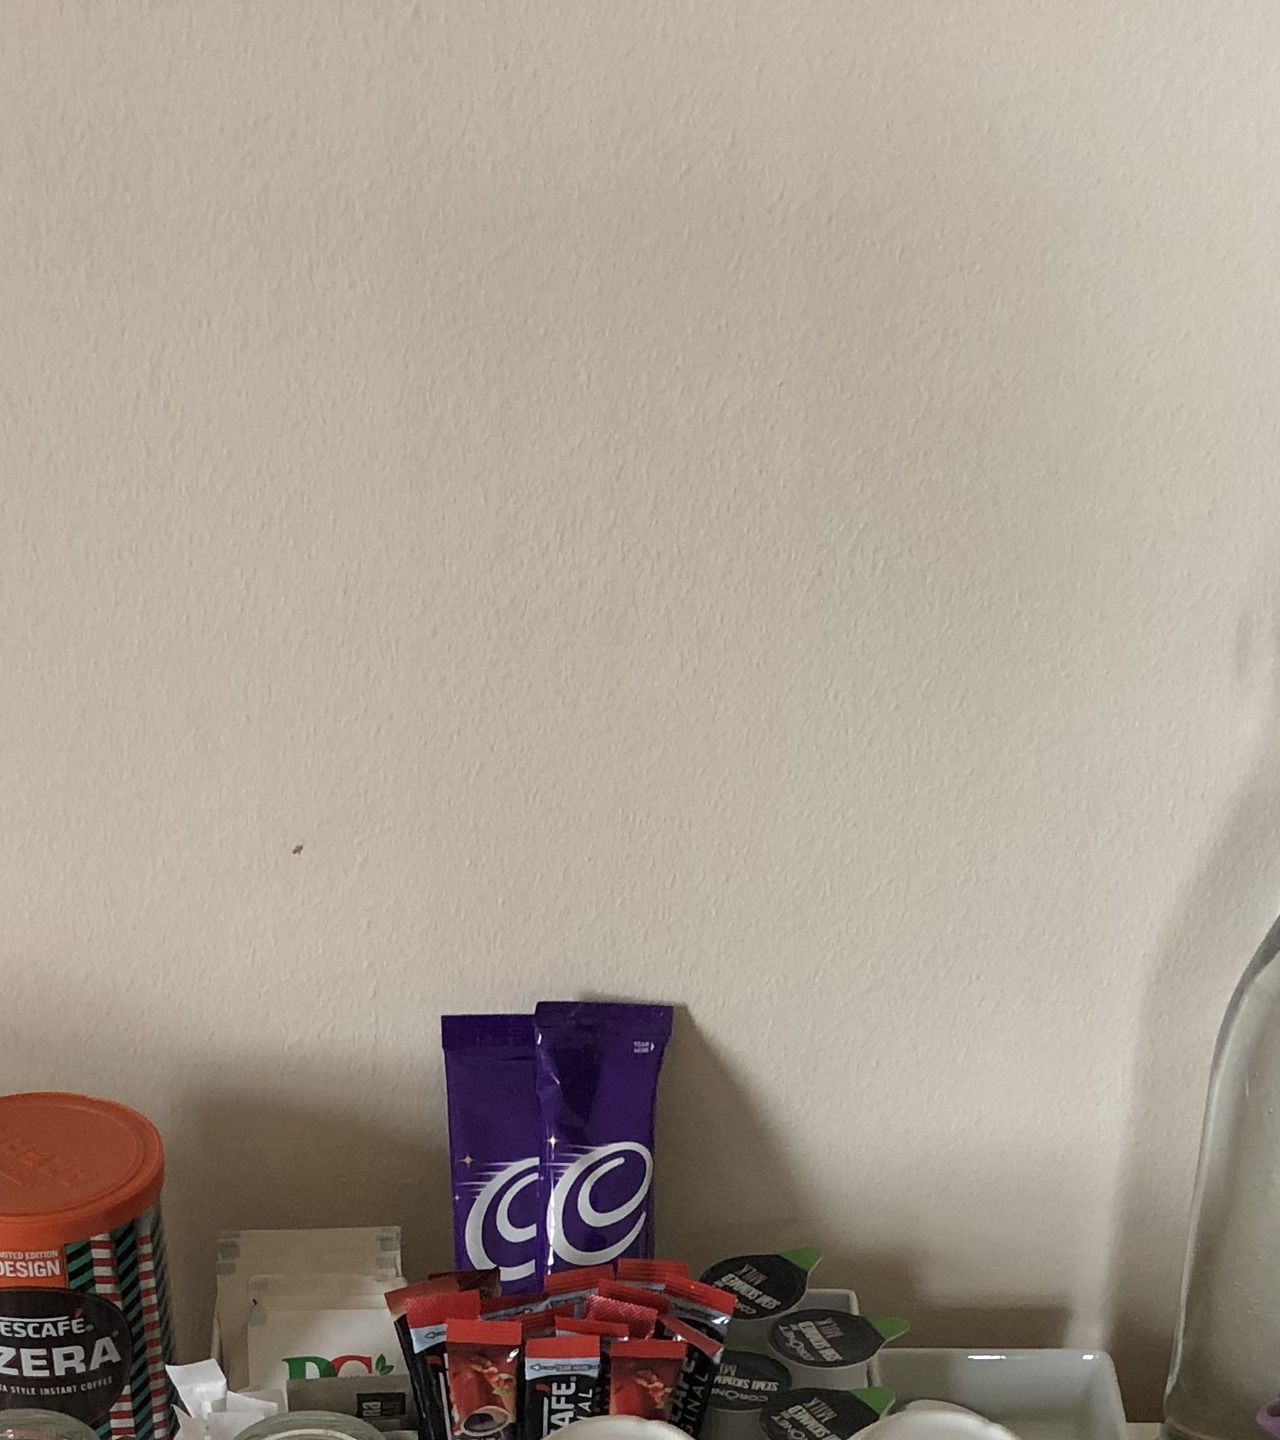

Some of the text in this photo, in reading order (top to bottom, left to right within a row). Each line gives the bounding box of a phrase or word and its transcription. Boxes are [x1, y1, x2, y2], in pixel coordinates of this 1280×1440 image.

[25, 1249, 59, 1260] EDITION
[10, 1386, 37, 1396] STYLE
[40, 1383, 78, 1396] INSTANT
[80, 1375, 113, 1391] COFFEE
[750, 1381, 780, 1392] SEMI
[801, 1396, 839, 1424] MILK
